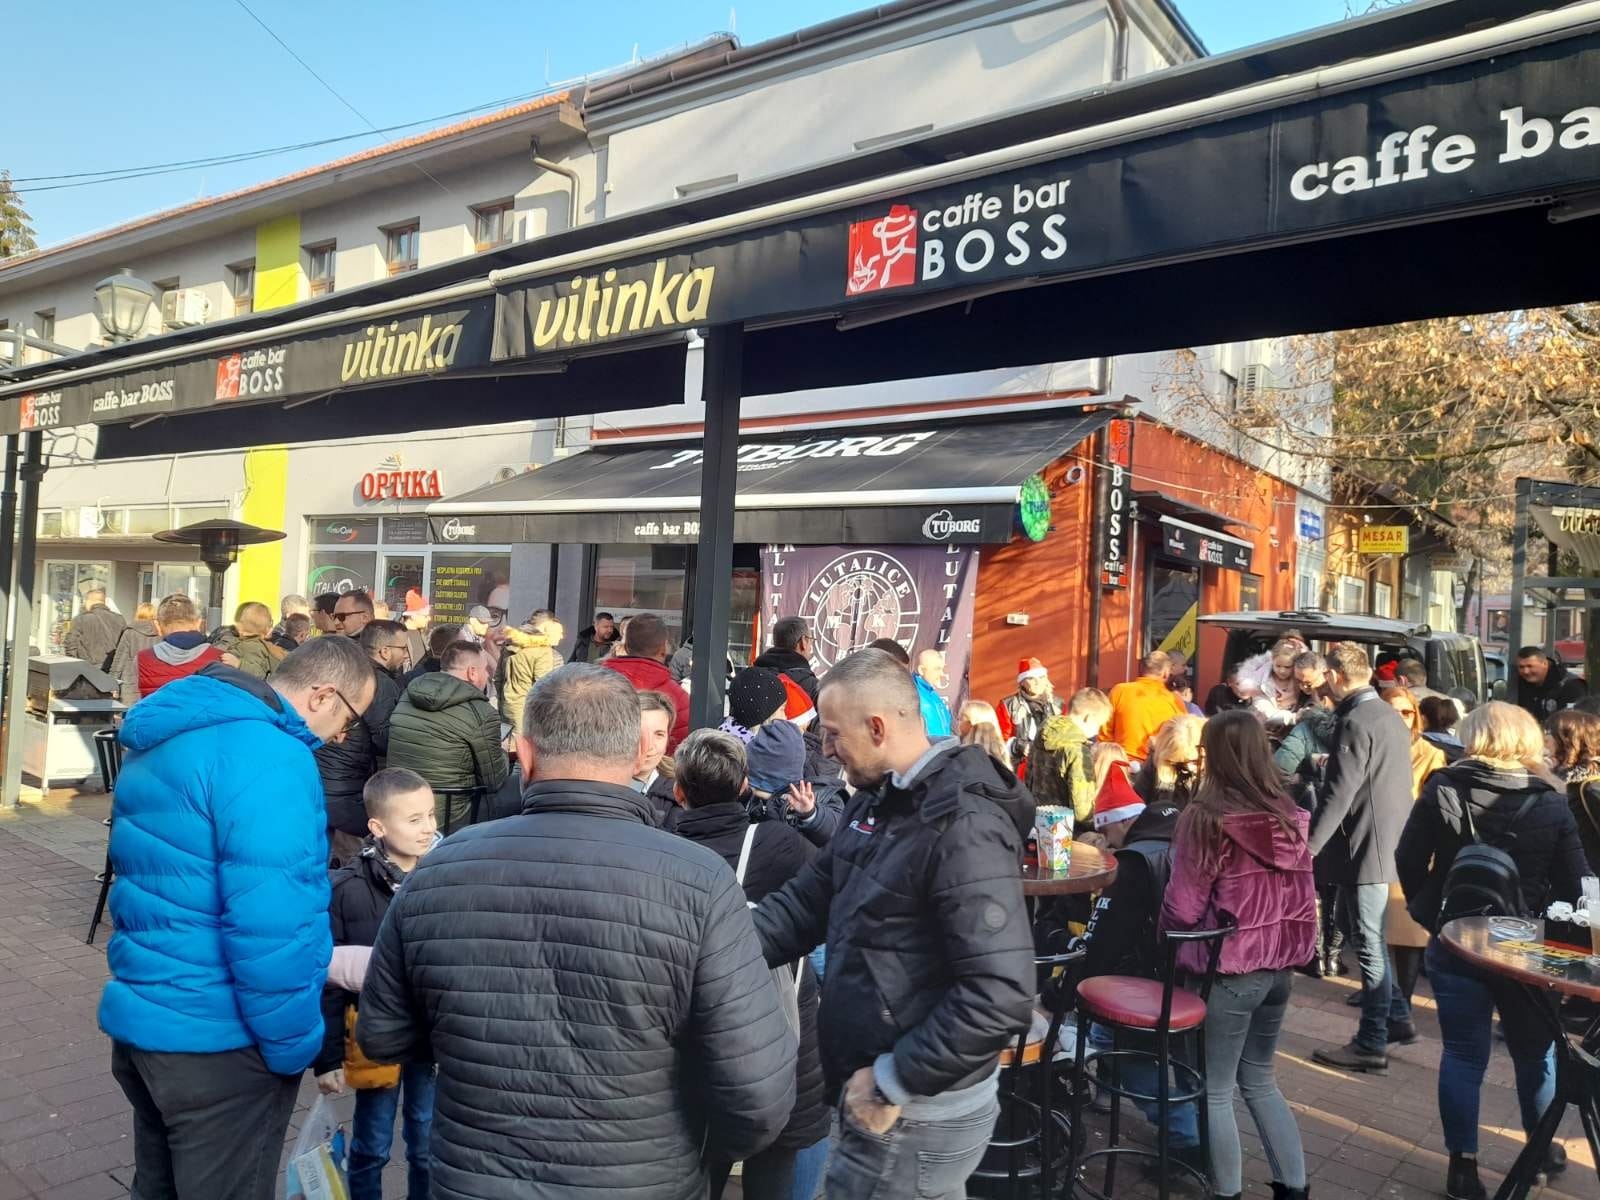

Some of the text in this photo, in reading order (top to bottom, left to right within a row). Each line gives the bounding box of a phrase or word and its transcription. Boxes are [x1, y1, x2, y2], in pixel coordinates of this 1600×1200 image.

[1290, 124, 1476, 201] caffe
[923, 177, 1071, 233] caffe bar
[922, 212, 1069, 282] BOSS
[532, 258, 715, 348] vitinka
[241, 348, 286, 369] caffe bar
[341, 314, 463, 382] vitinka
[93, 380, 174, 412] caffe bar BOSS
[238, 366, 284, 396] BOSS
[33, 405, 60, 426] BOSS
[649, 430, 938, 470] TBORG
[361, 469, 444, 500] OPTIKA
[634, 521, 701, 536] caffe bar BO
[931, 518, 981, 534] TUBORG
[1109, 464, 1124, 561] BOSS
[1362, 530, 1403, 542] MESAR
[809, 556, 911, 605] LUTALICE
